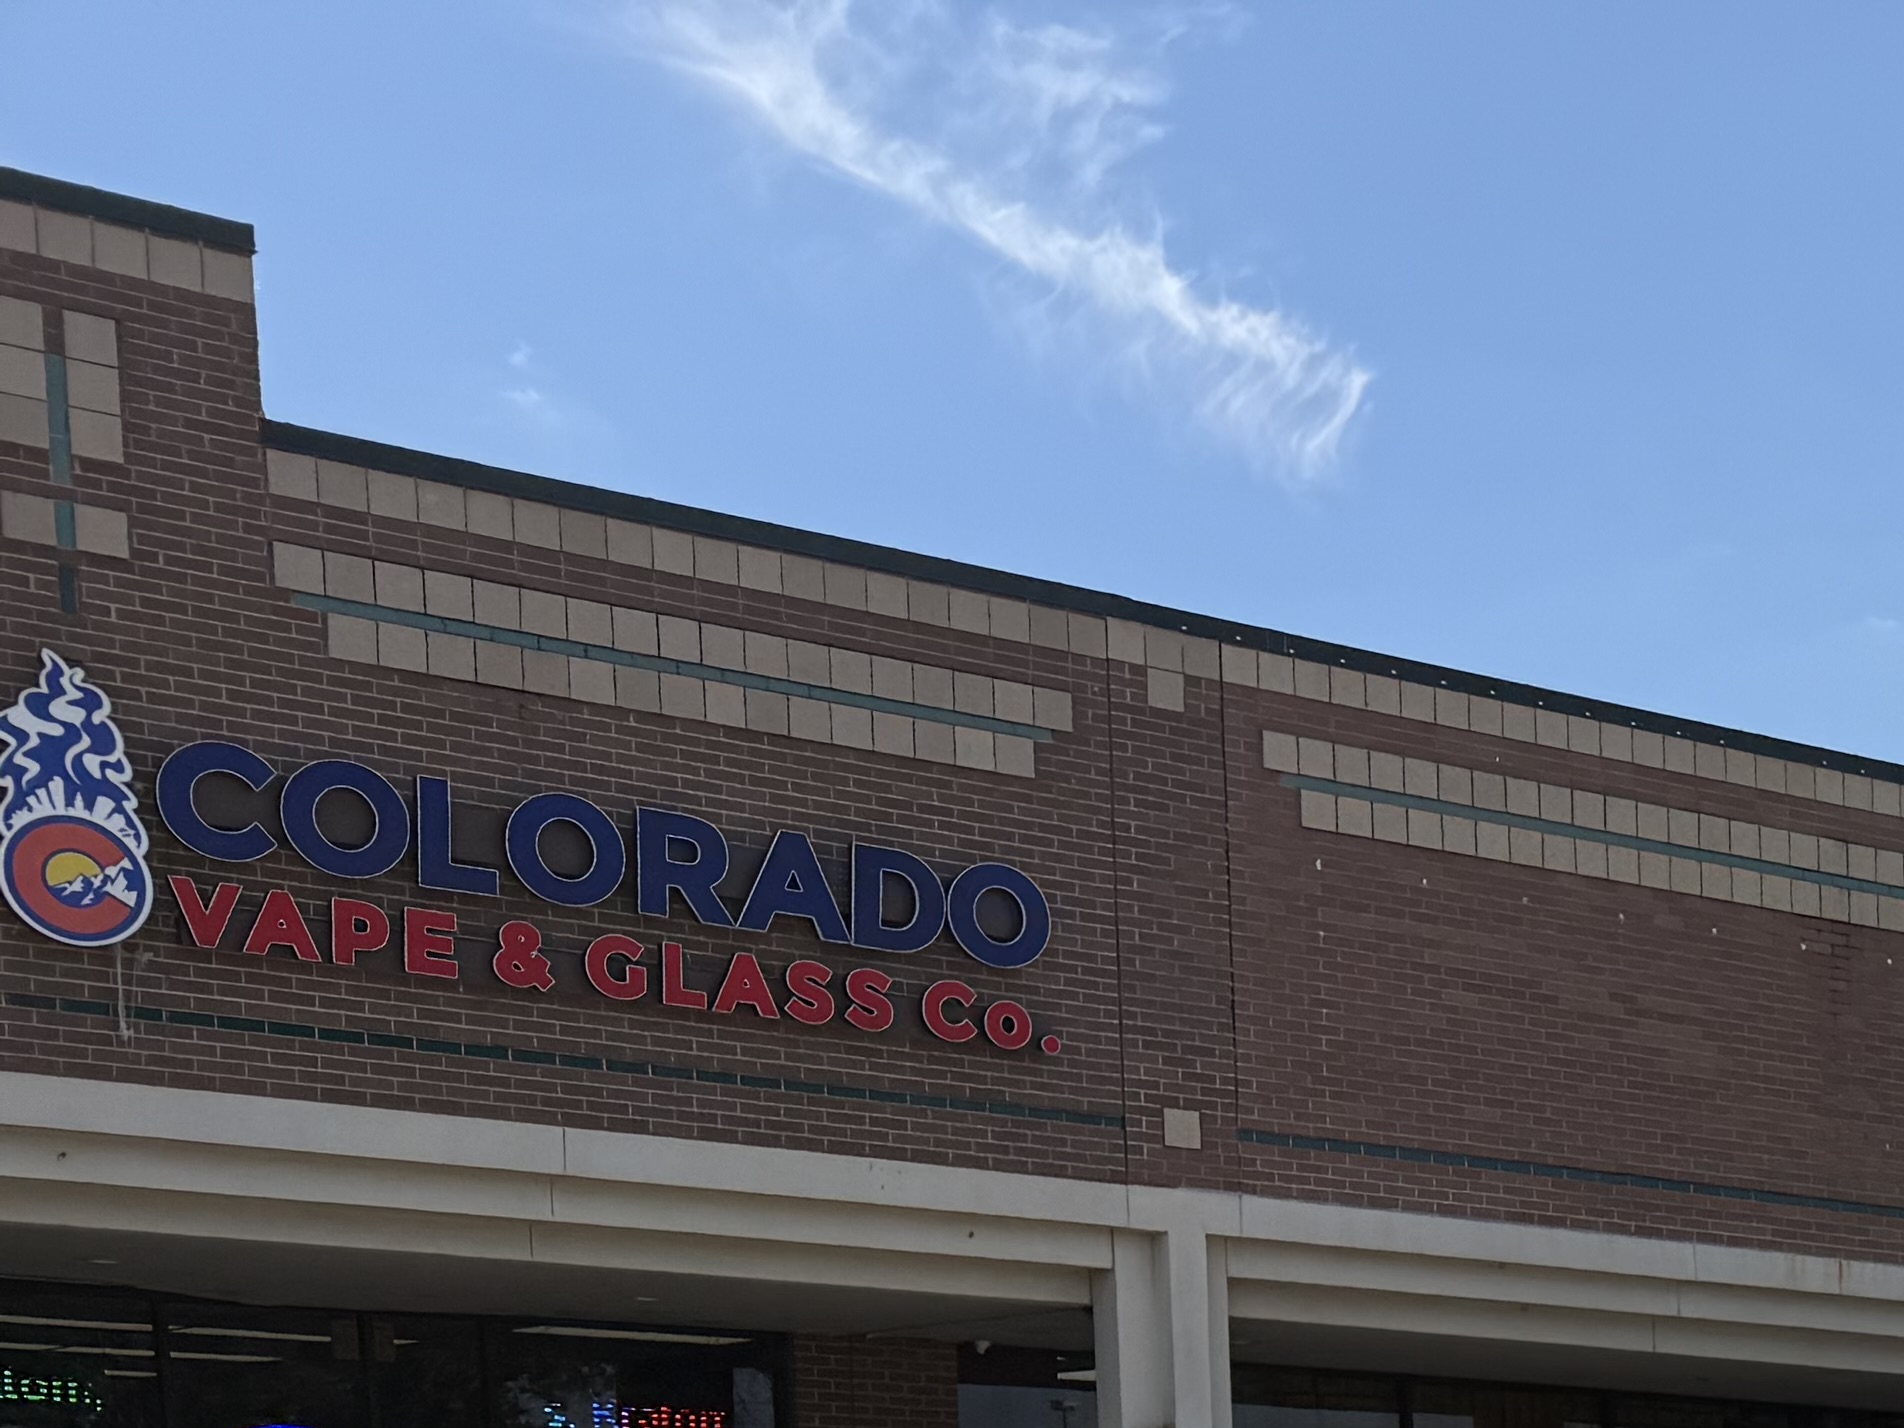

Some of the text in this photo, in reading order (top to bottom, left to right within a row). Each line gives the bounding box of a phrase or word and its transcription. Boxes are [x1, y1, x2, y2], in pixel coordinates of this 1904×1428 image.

[156, 740, 1050, 968] COLORADO
[166, 874, 459, 979] VAPE
[492, 919, 557, 993] &
[584, 933, 895, 1032] GLASS
